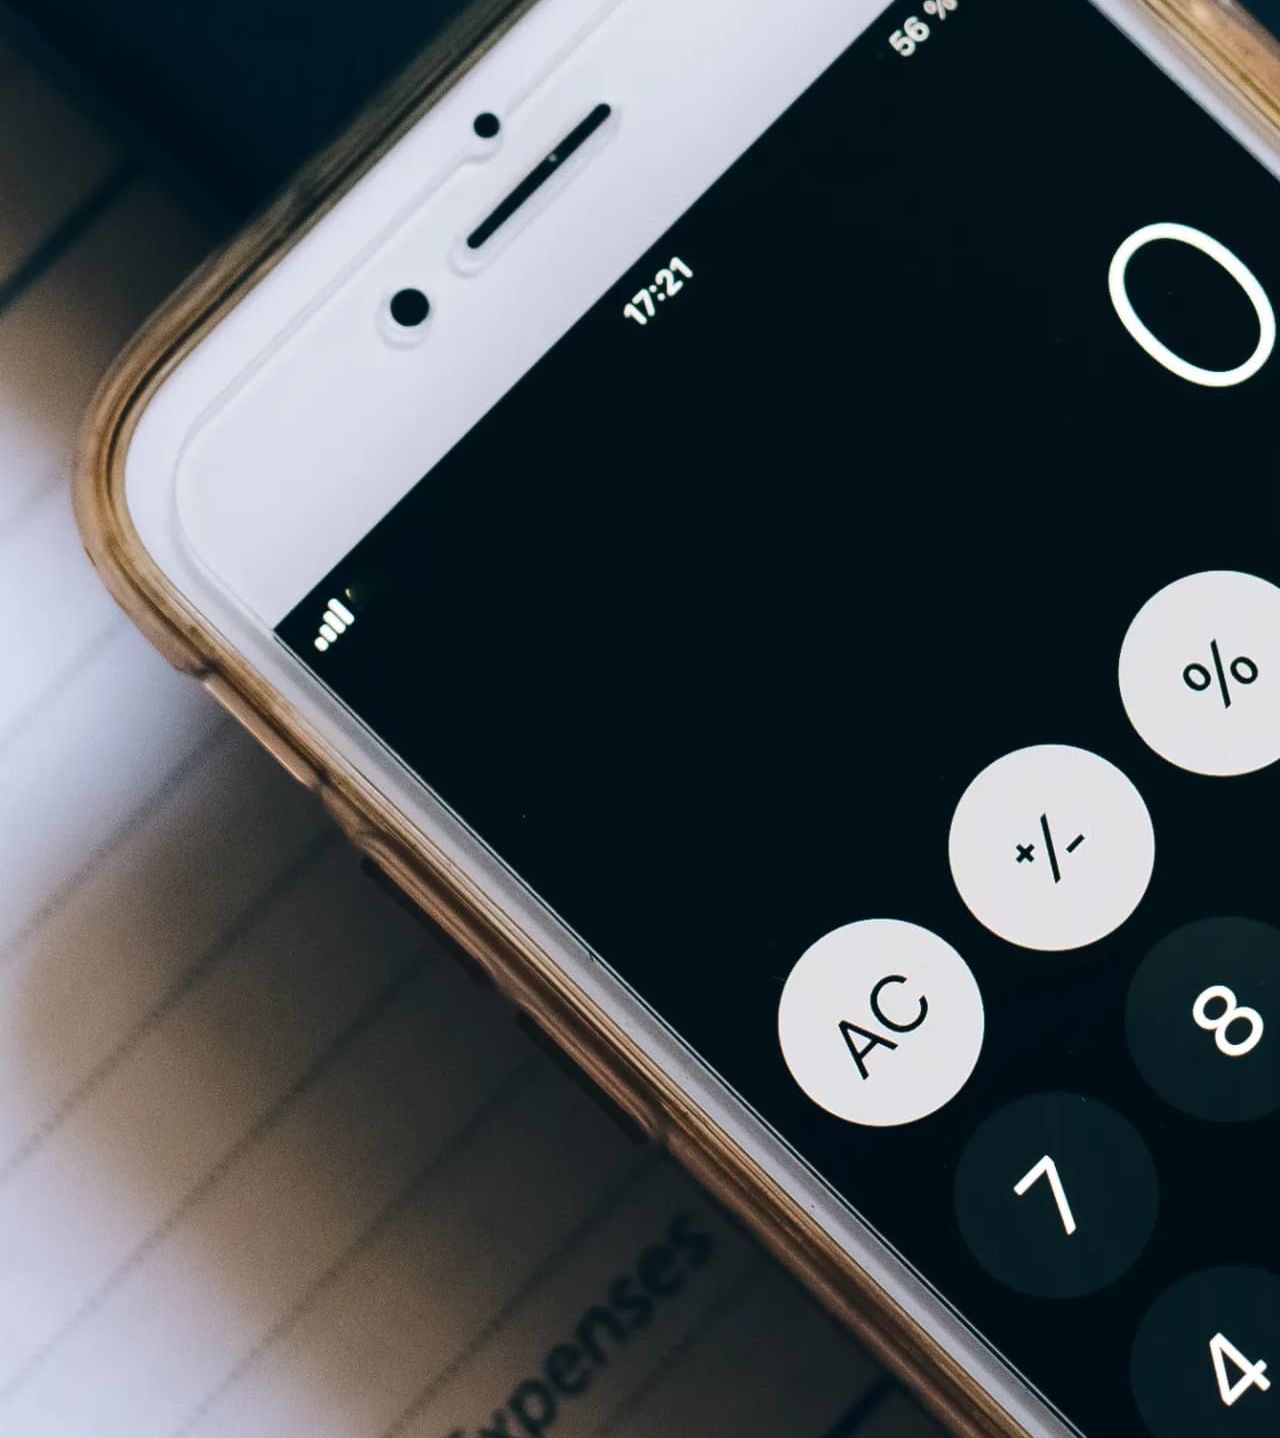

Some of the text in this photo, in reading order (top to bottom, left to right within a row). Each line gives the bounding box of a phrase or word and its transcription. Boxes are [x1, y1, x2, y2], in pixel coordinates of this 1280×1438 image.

[624, 256, 694, 325] 17:21
[888, 15, 930, 57] 56
[1109, 222, 1275, 387] 0
[836, 974, 932, 1076] AC
[1180, 638, 1260, 708] %
[1014, 1155, 1076, 1234] 7
[1193, 986, 1263, 1056] 8
[1210, 1333, 1272, 1407] 4
